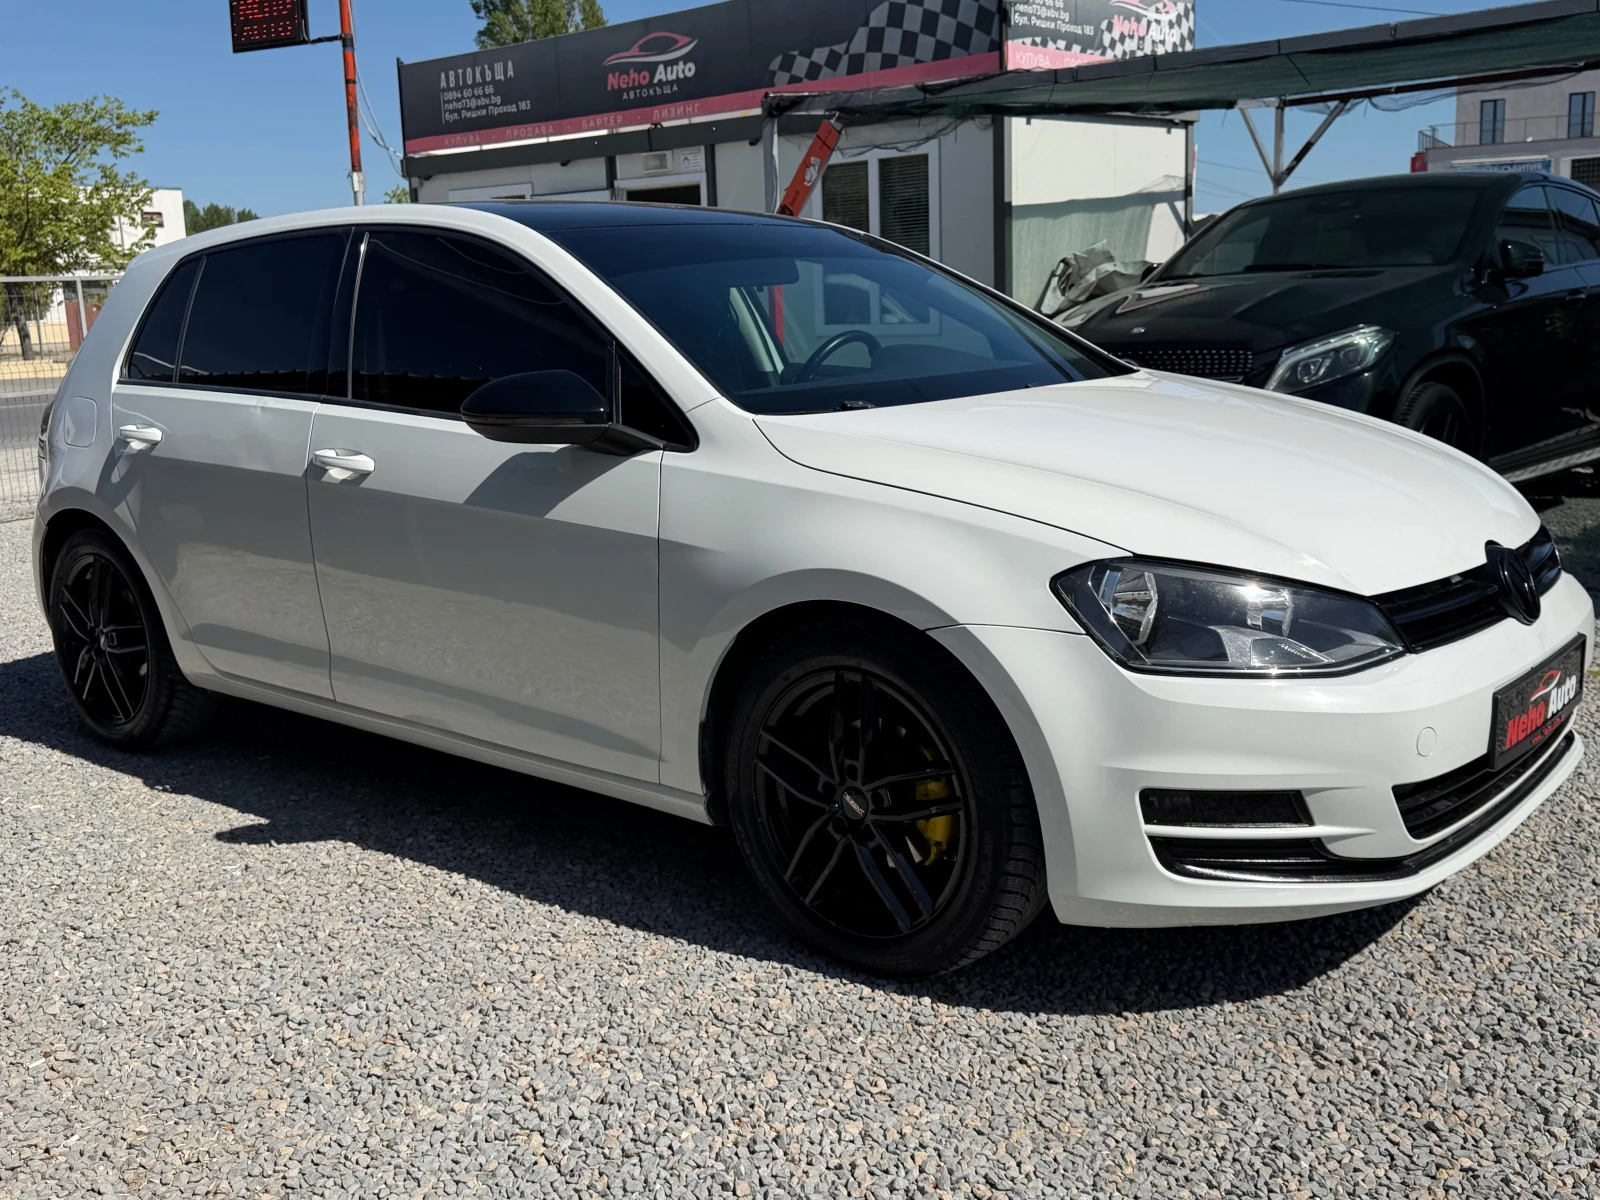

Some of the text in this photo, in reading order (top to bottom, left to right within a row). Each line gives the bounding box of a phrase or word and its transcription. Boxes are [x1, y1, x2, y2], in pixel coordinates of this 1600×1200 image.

[1014, 13, 1095, 36] бул. Ришки Проход 183
[1113, 14, 1178, 42] Neho Auto
[1015, 50, 1050, 67] КУПУВА
[440, 60, 514, 89] АВТОКЪЩА
[607, 60, 696, 91] Neho Auto
[443, 84, 494, 101] 0894 60 66 66
[444, 95, 501, 111] neho73@abv.bg
[622, 83, 678, 100] АВТОКЪЩА
[445, 100, 531, 123] бул. Ришки Проход 183
[444, 103, 700, 146] КУПУВА ПРОДАВА БАРТЕР ЛИЗИНГ
[1505, 701, 1546, 750] Neho
[1547, 674, 1577, 719] Auto
